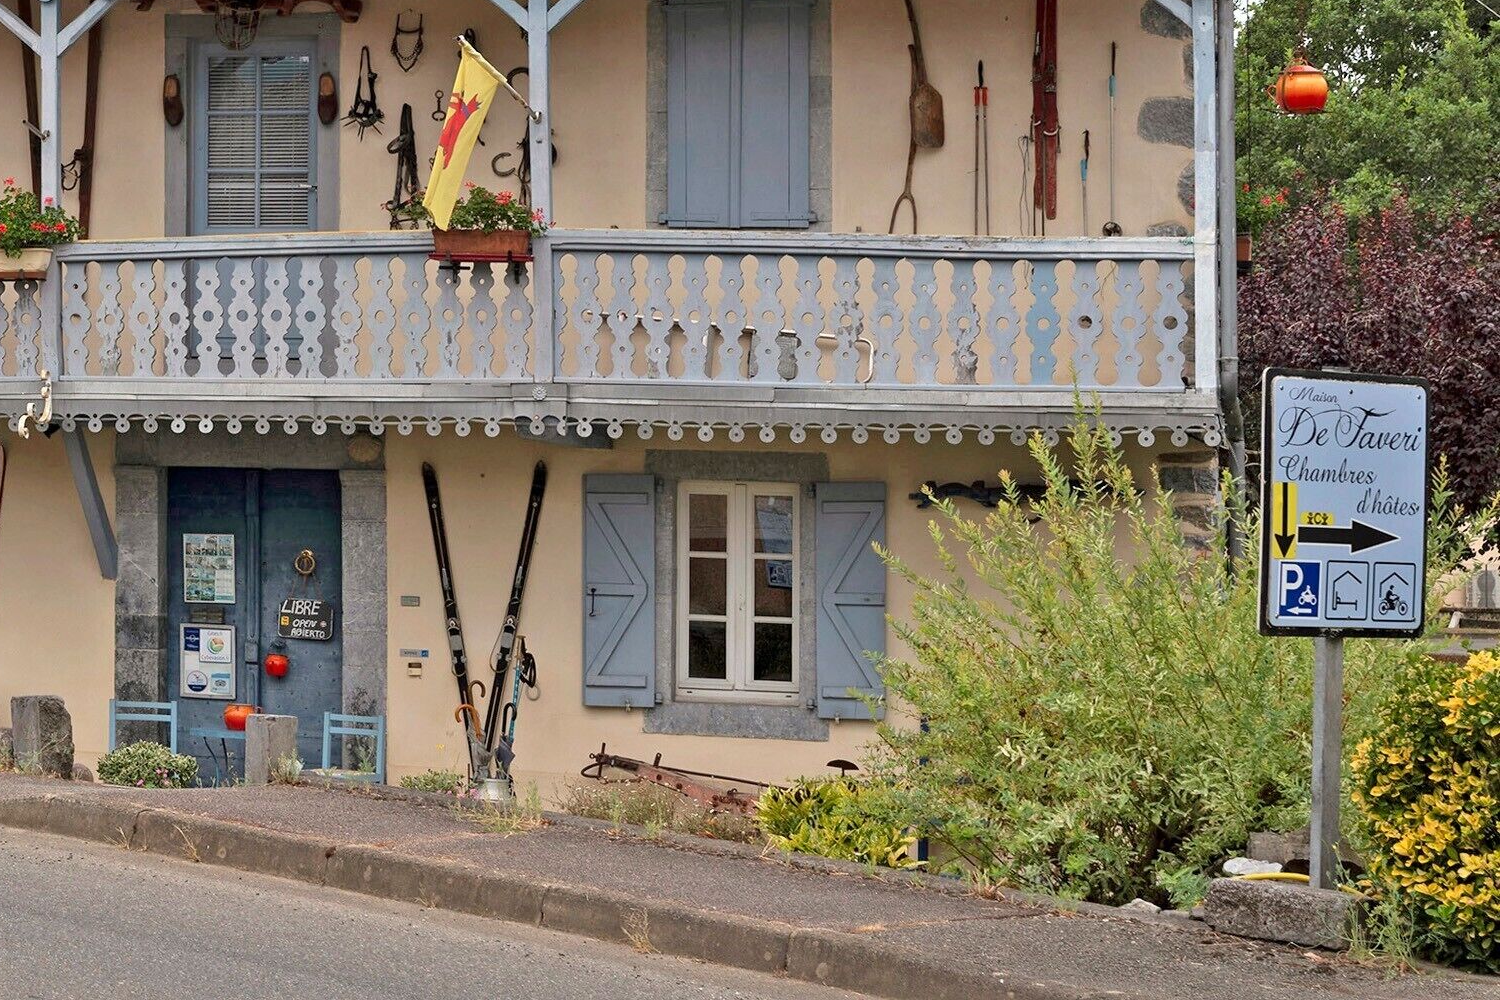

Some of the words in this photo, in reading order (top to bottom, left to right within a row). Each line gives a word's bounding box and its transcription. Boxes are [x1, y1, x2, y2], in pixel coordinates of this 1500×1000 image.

[1289, 386, 1338, 403] Maison
[1279, 406, 1329, 447] De
[1279, 454, 1377, 484] Chambres
[1356, 487, 1419, 515] d'hôtes
[1280, 563, 1304, 606] P
[281, 599, 322, 615] LIBRE
[290, 627, 326, 639] ABIERTO
[292, 618, 318, 628] OPEN
